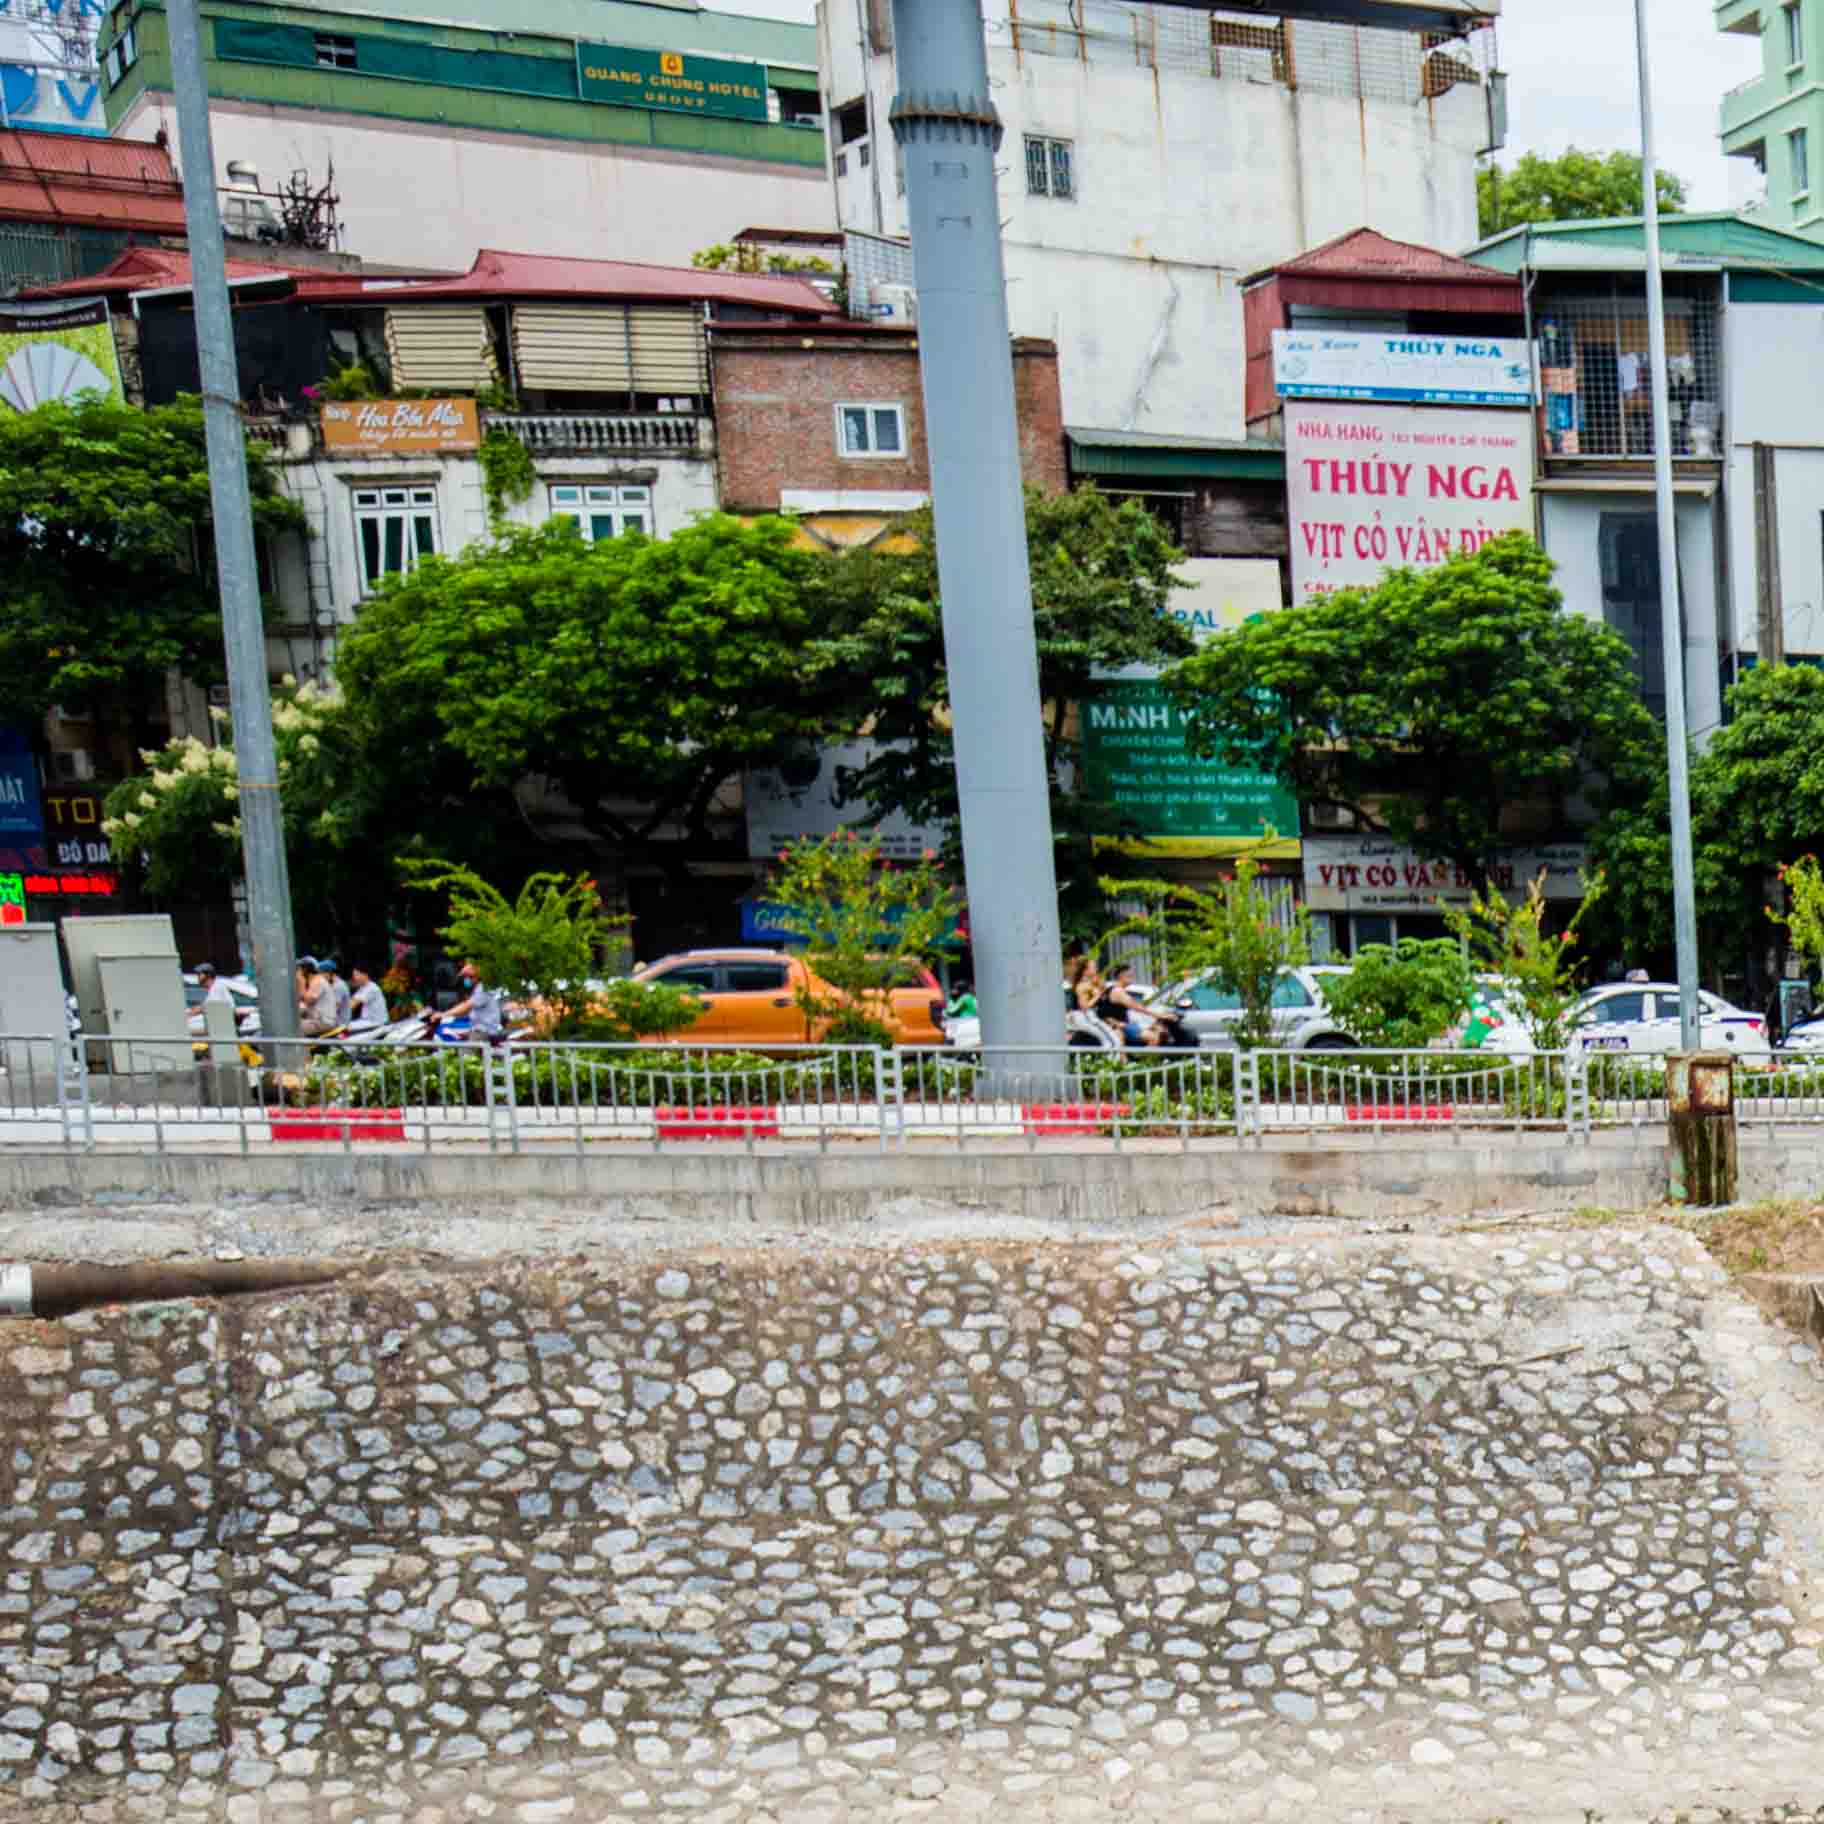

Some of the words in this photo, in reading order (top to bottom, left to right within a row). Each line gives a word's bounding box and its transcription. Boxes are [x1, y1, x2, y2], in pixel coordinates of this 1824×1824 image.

[585, 65, 643, 85] QUANG
[649, 74, 704, 93] CHUNG
[708, 81, 761, 99] HOTEL
[1454, 342, 1503, 358] NGA
[1302, 452, 1413, 498] THÚY
[1427, 464, 1520, 501] NGA
[1300, 522, 1346, 569] VỊT
[1354, 510, 1388, 561] CỎ
[1090, 705, 1169, 729] MINH
